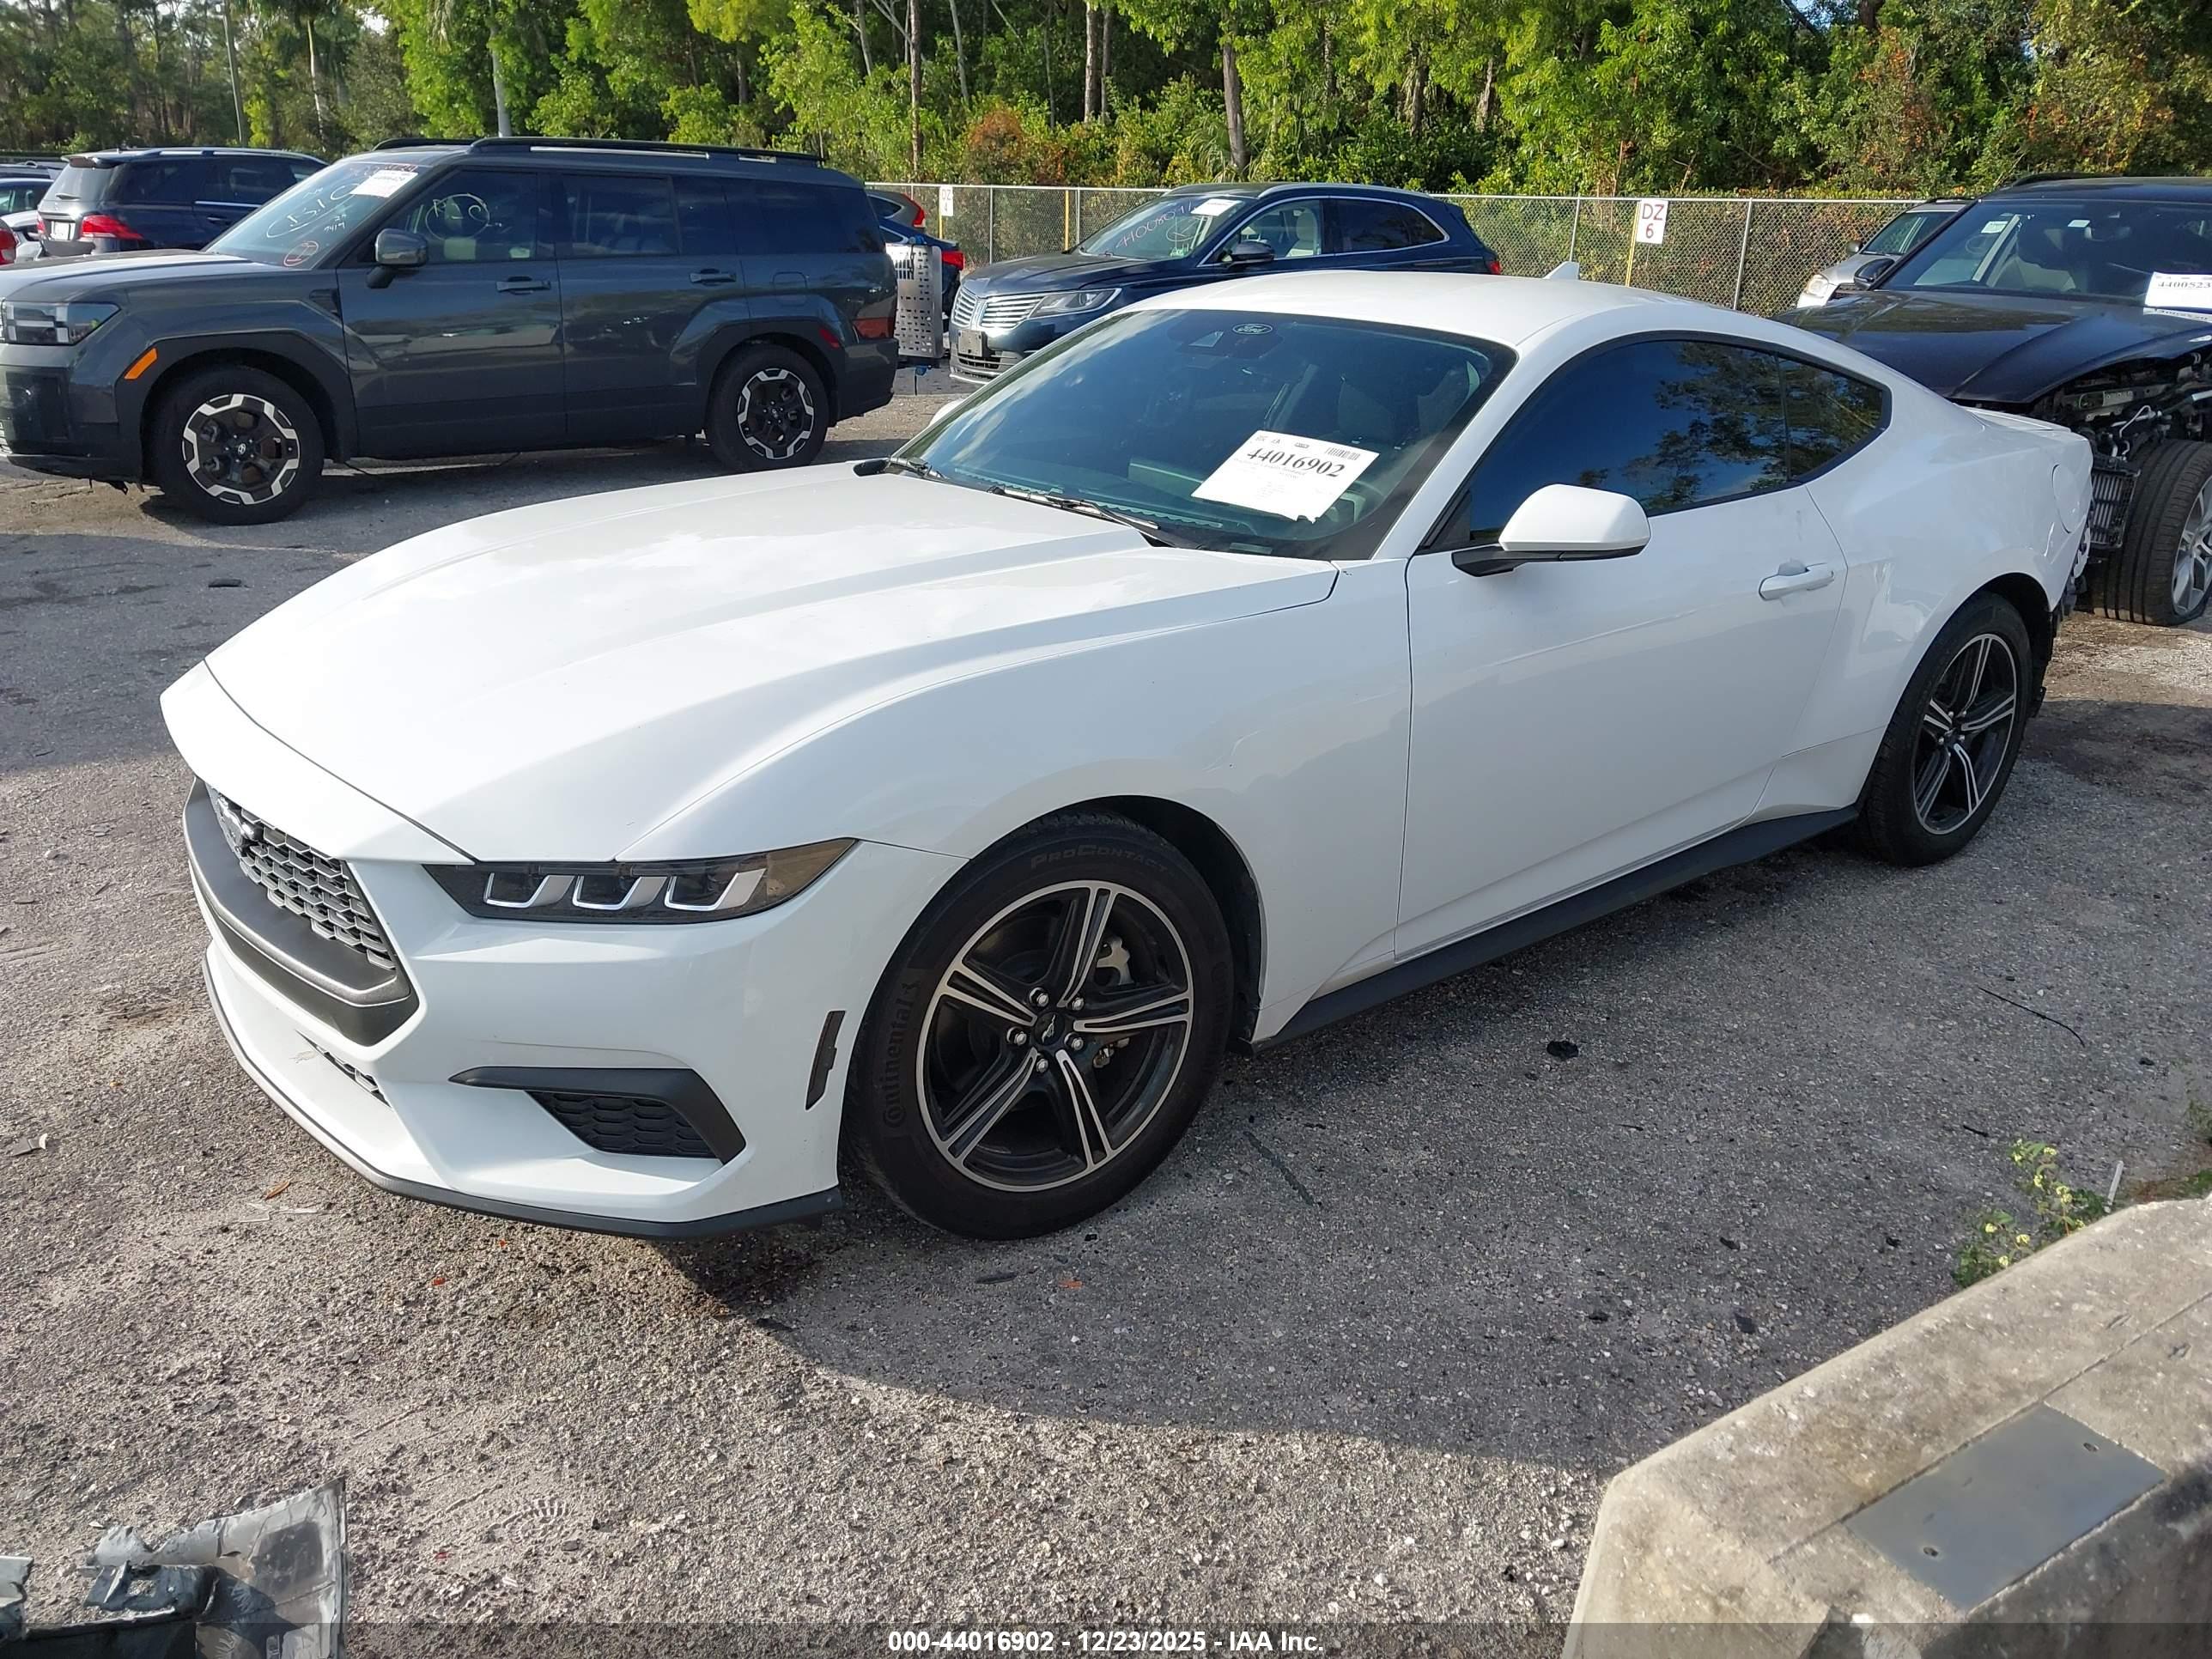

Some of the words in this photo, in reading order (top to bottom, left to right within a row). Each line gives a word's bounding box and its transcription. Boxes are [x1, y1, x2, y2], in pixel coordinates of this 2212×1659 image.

[1641, 203, 1665, 221] DZ
[1645, 222, 1655, 239] 6
[1235, 323, 1268, 334] Ford
[1247, 447, 1346, 477] 44016902
[883, 998, 915, 1128] Continental
